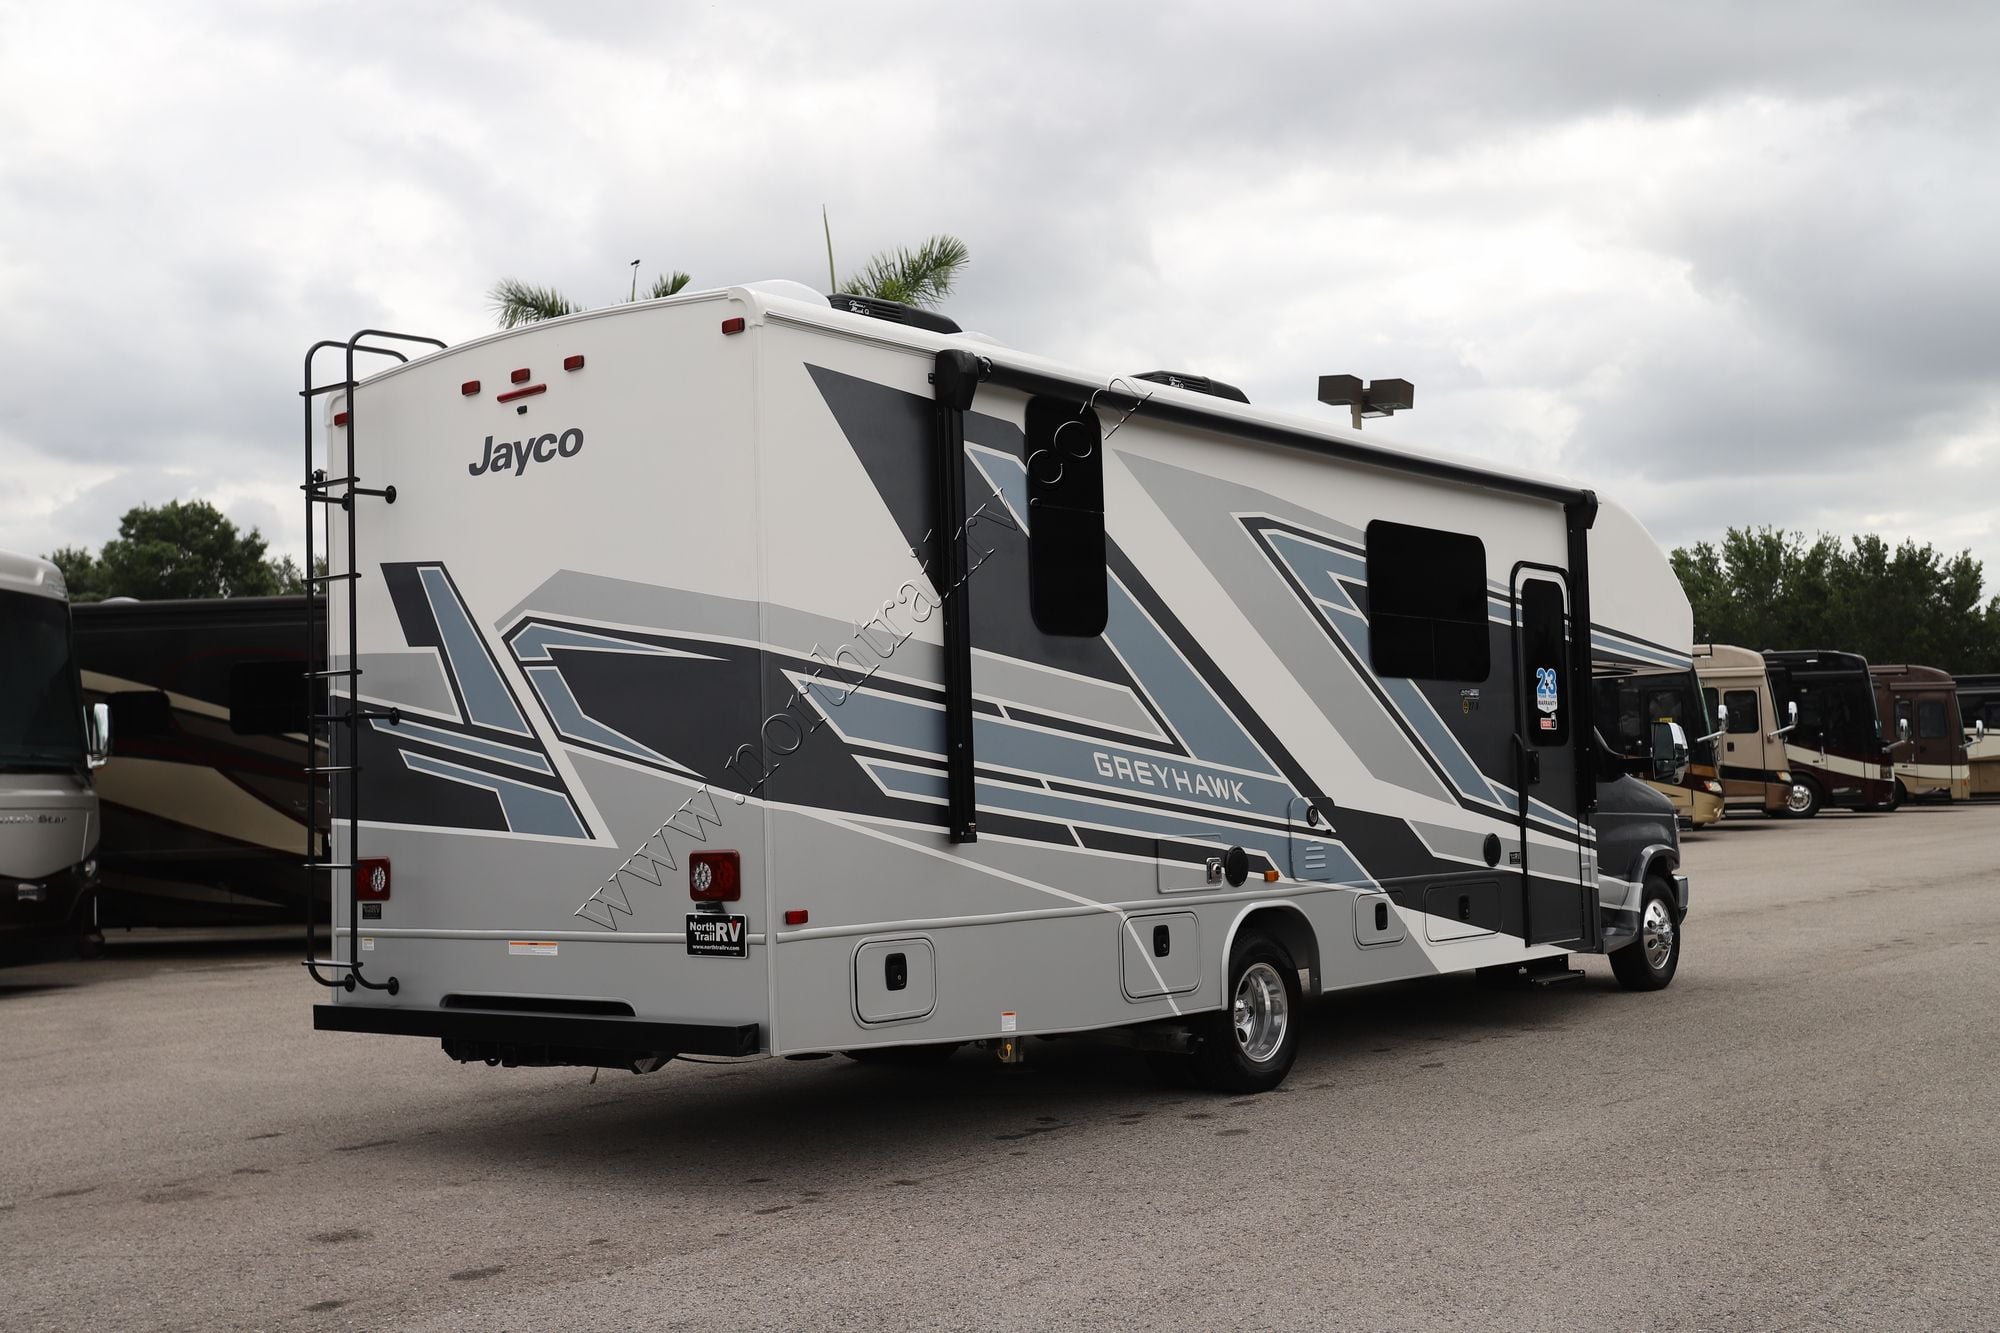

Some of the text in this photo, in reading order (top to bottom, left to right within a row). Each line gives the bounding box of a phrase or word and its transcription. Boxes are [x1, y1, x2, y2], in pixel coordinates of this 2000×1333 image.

[468, 427, 584, 477] Jayco
[1093, 751, 1251, 805] GREYHAWK
[690, 921, 741, 942] North RV
[695, 931, 715, 941] Trail
